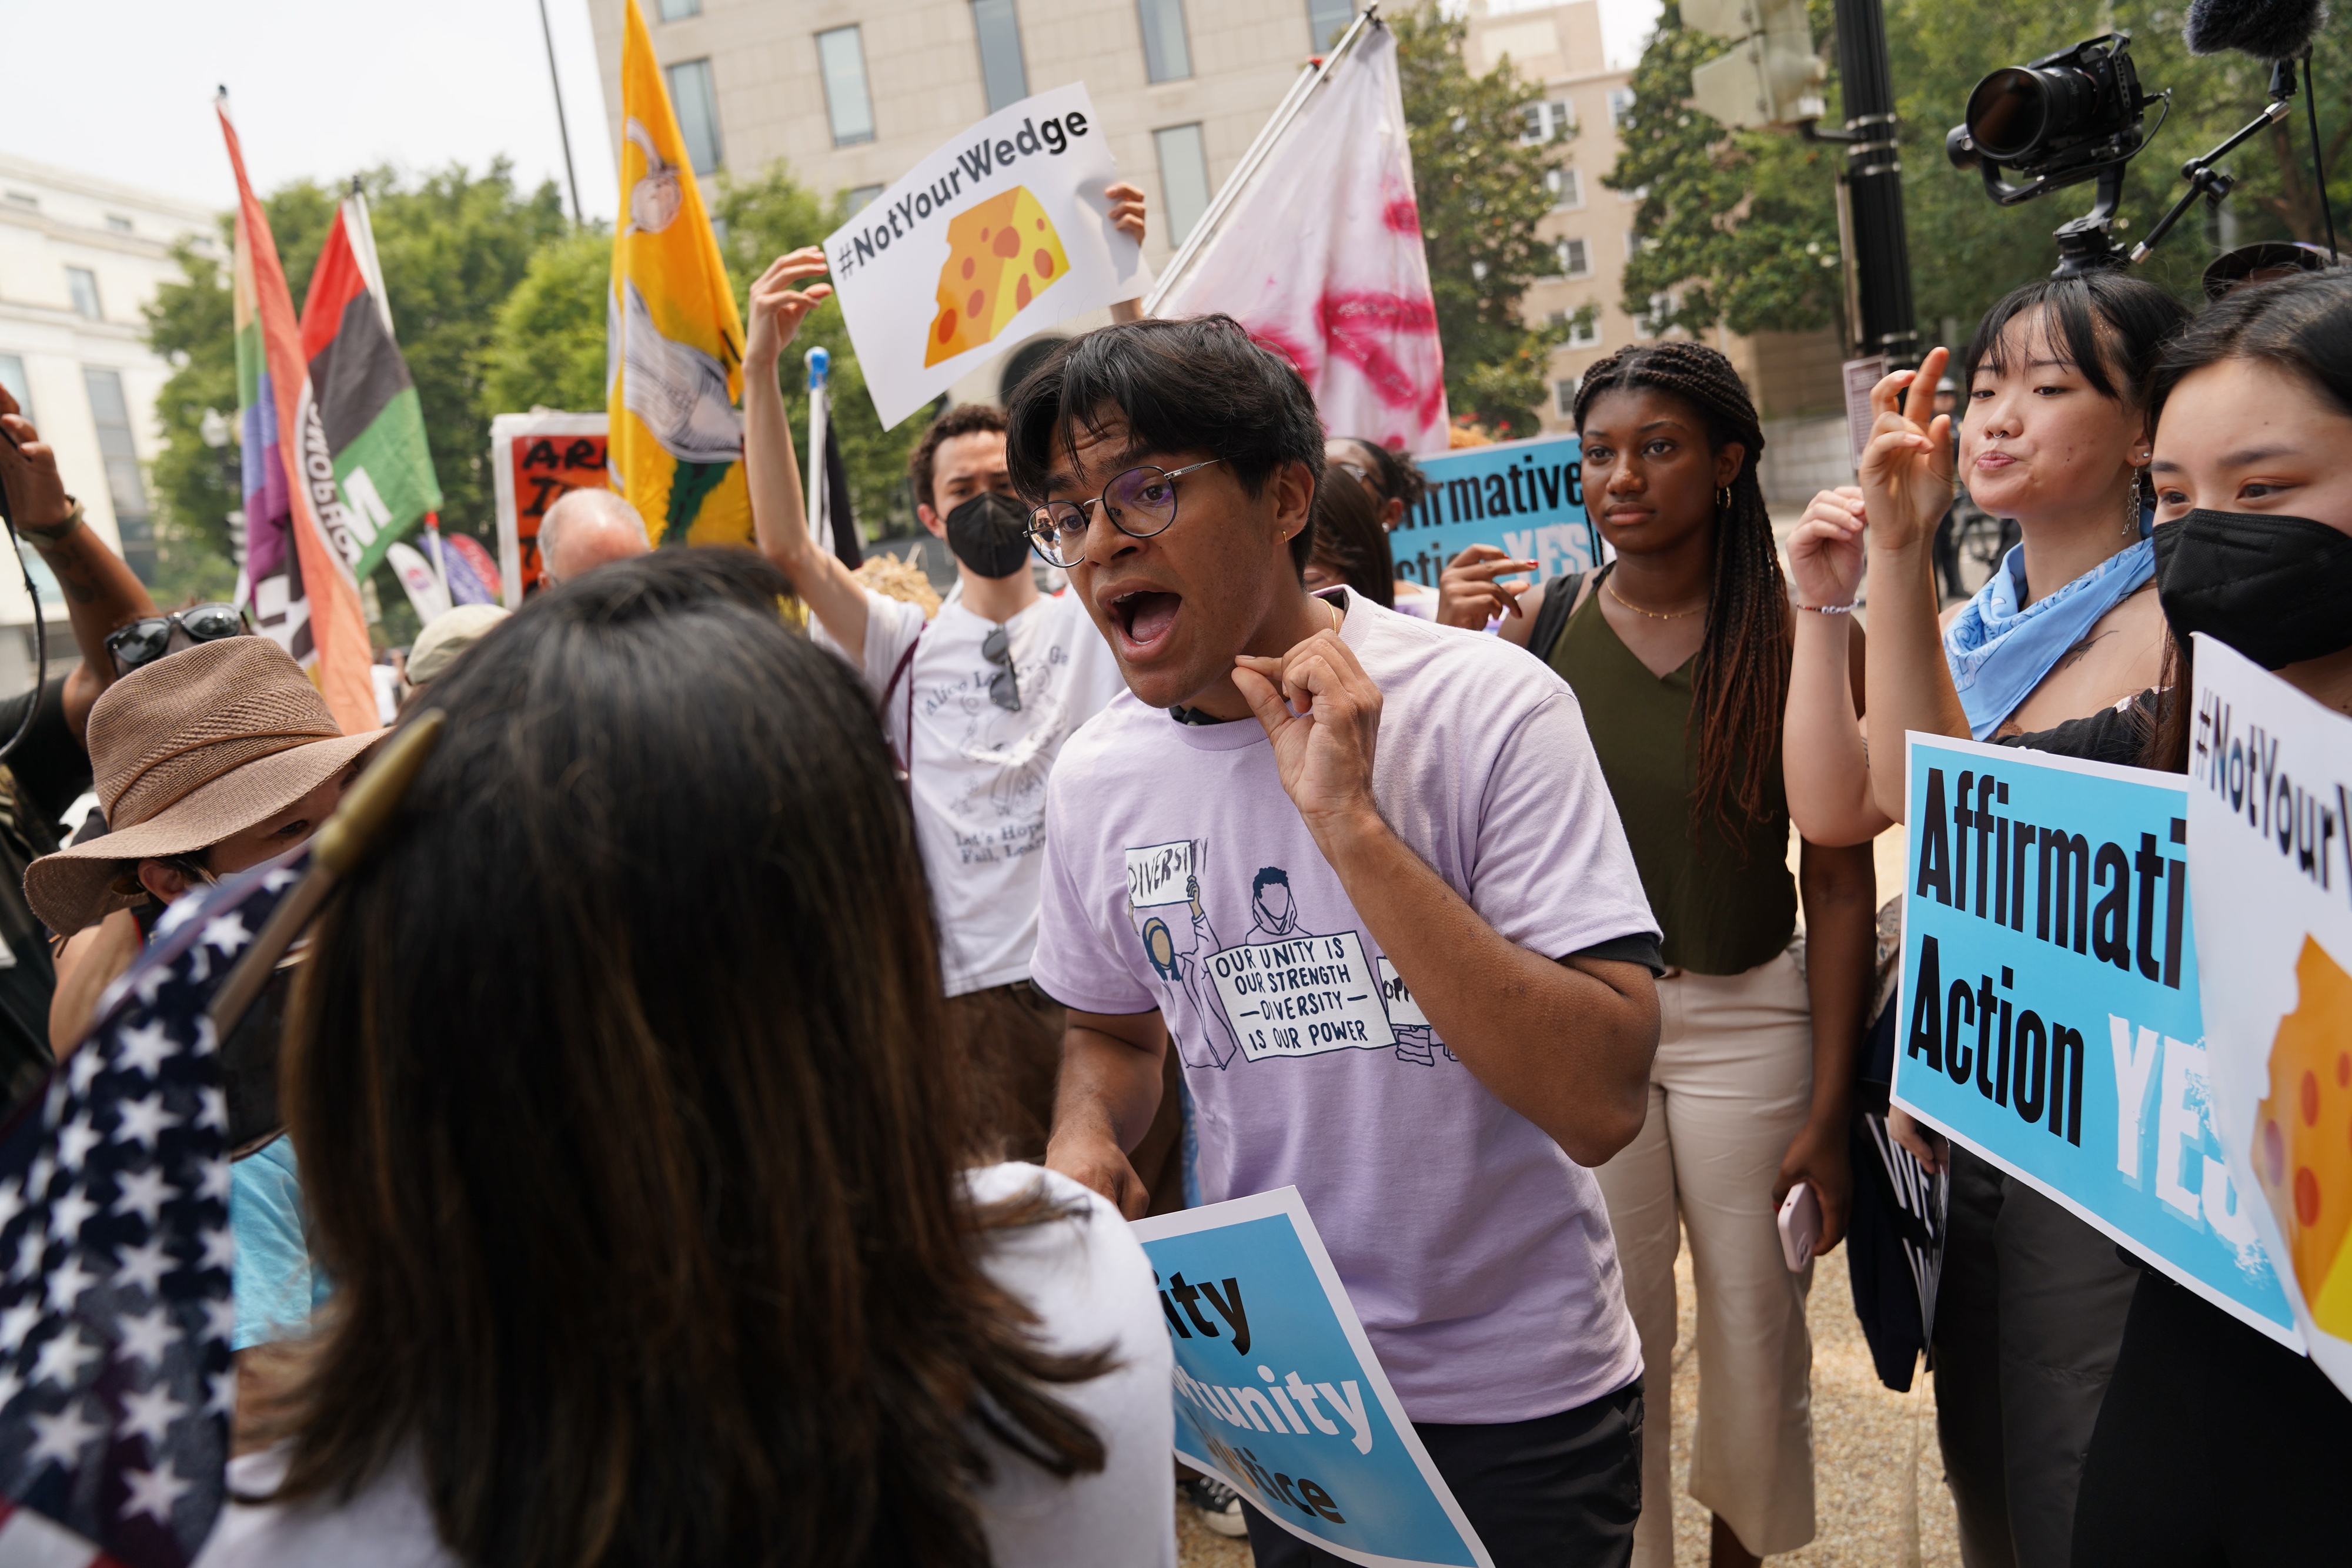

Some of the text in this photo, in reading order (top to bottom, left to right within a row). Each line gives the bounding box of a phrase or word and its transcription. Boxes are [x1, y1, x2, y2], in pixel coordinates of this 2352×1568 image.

[837, 112, 1088, 281] #NotYourWedge
[1392, 454, 1583, 531] irmative
[1502, 522, 1590, 587] YES
[1128, 837, 1208, 898] DIVERSITY
[1916, 767, 2186, 991] Affirmati
[1216, 937, 1344, 978] OUR UNITY IS
[1235, 964, 1351, 995] OUR STRENGTH
[1248, 1019, 1368, 1051] IS OUR POWER
[1261, 990, 1343, 1021] DIVERSITY
[1907, 934, 2084, 1148] Action
[1152, 1269, 1251, 1356] ity
